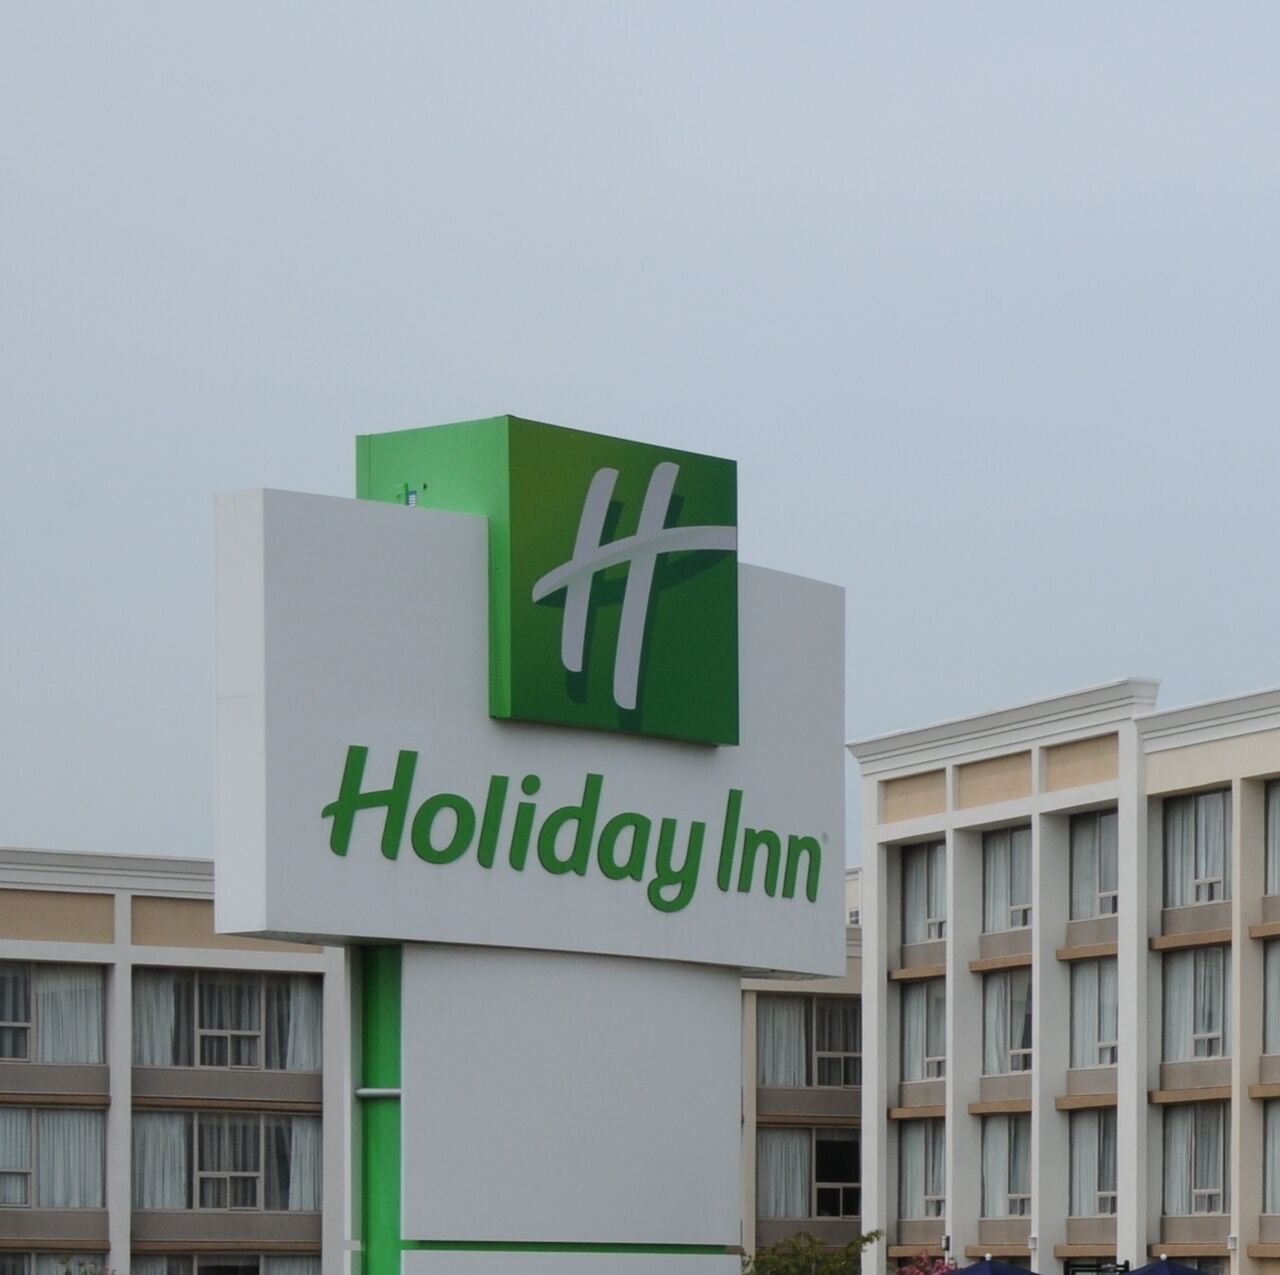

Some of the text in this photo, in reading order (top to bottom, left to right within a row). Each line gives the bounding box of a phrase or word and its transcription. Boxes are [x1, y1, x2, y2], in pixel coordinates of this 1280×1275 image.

[531, 461, 738, 711] H
[321, 744, 823, 914] Holiday Inn
